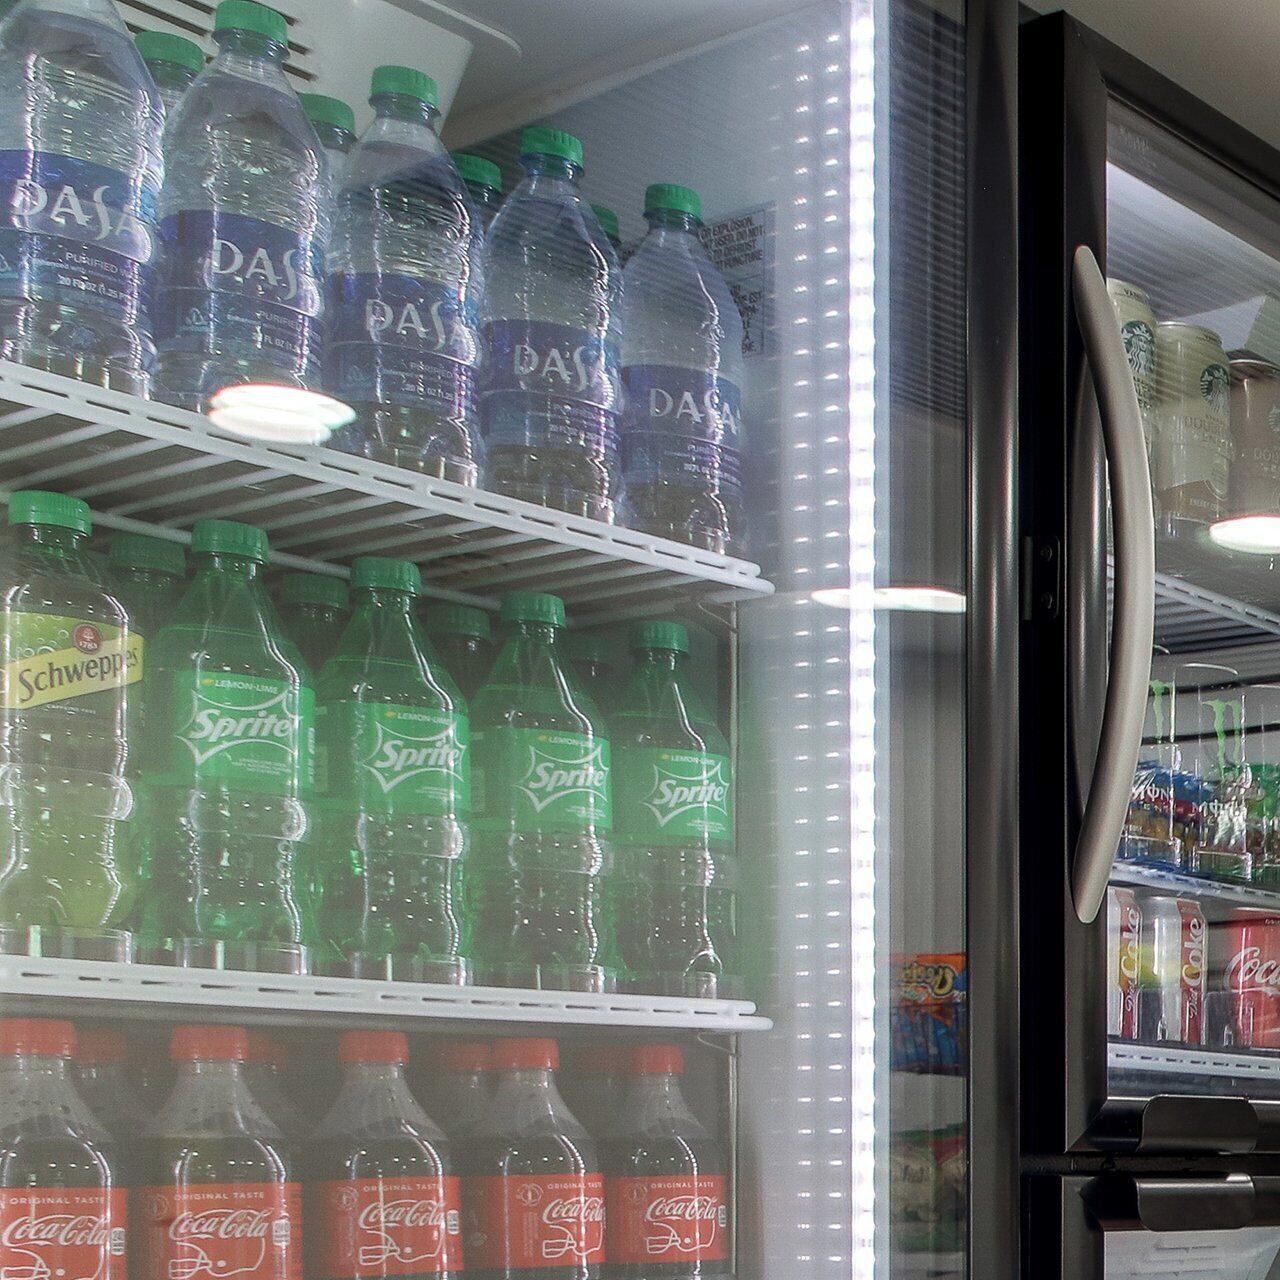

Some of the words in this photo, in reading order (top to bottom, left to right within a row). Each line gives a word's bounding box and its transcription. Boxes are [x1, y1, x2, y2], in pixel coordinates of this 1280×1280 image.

[18, 645, 138, 701] Schweppes
[214, 680, 279, 694] LEMON-LIME
[189, 708, 295, 742] Sprite
[376, 737, 462, 769] Sprite
[530, 763, 605, 790] Sprite
[655, 780, 725, 805] Sprite
[1121, 908, 1140, 979] Coke
[1182, 917, 1202, 987] Coke
[175, 1193, 229, 1202] ORIGINAL
[233, 1190, 265, 1200] TASTE
[363, 1184, 412, 1193] ORIGINAL
[547, 1182, 583, 1190] ORIGINAL
[651, 1182, 693, 1190] ORIGINAL
[694, 1181, 715, 1189] TASTE
[10, 1196, 70, 1206] ORIGINAL
[358, 1199, 445, 1229] Coca-Cola
[542, 1196, 606, 1223] Coca-Cola
[645, 1195, 719, 1221] Coca-Cola
[2, 1214, 108, 1247] Coca-Cola
[168, 1207, 273, 1240] Coca-Cola
